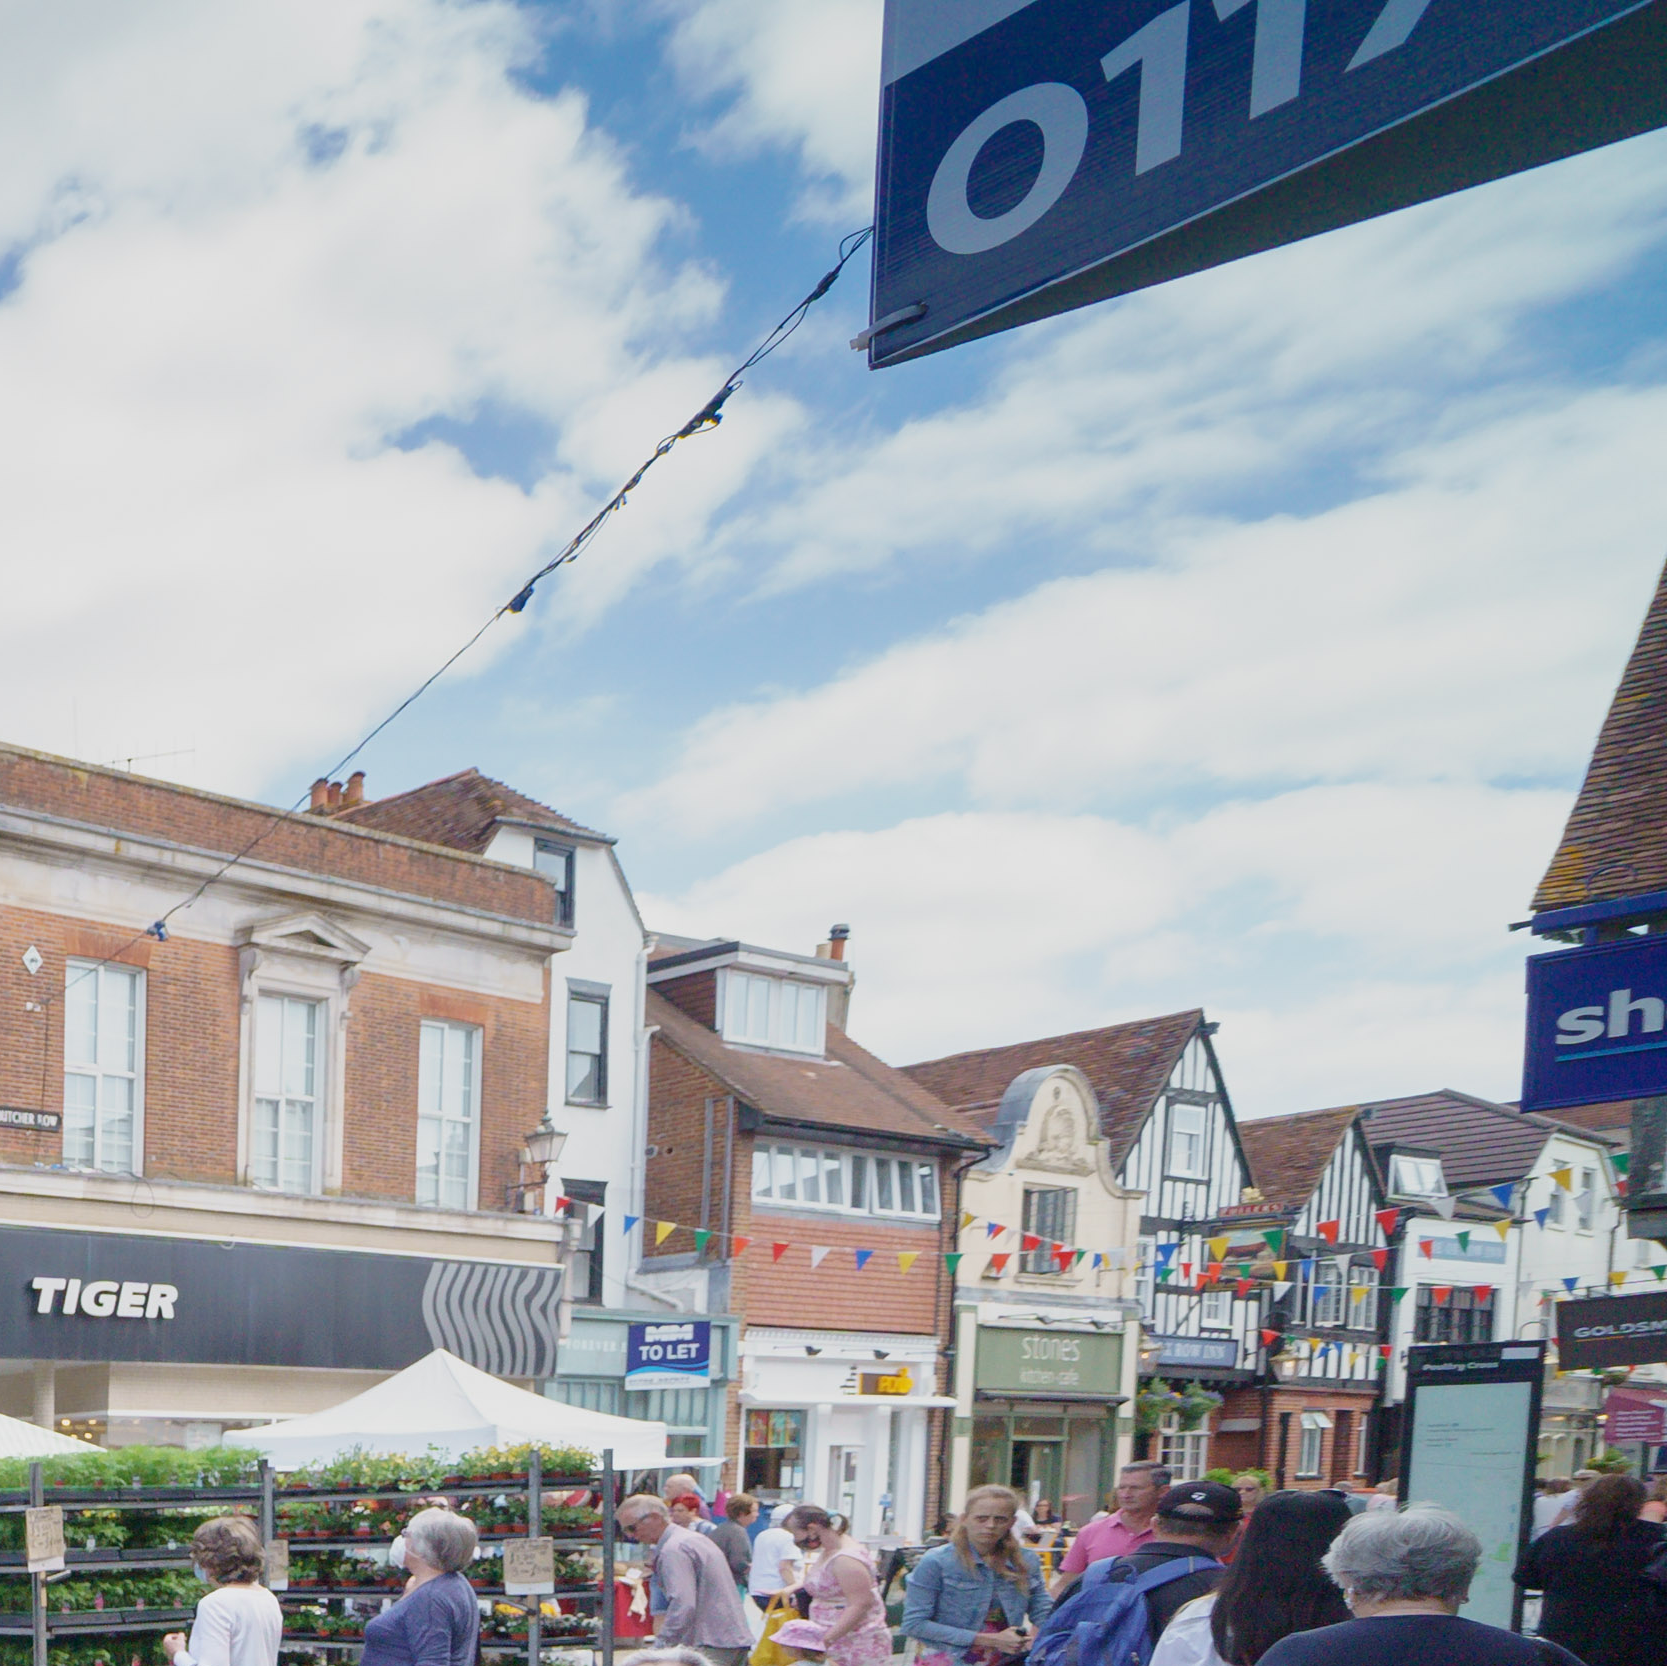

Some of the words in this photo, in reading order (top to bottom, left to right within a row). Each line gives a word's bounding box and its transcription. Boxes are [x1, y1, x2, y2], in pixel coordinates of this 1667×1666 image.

[37, 1113, 58, 1127] ROW
[32, 1277, 178, 1319] TIGER
[639, 1345, 663, 1360] TO
[667, 1344, 699, 1359] LET
[1021, 1336, 1080, 1361] stones
